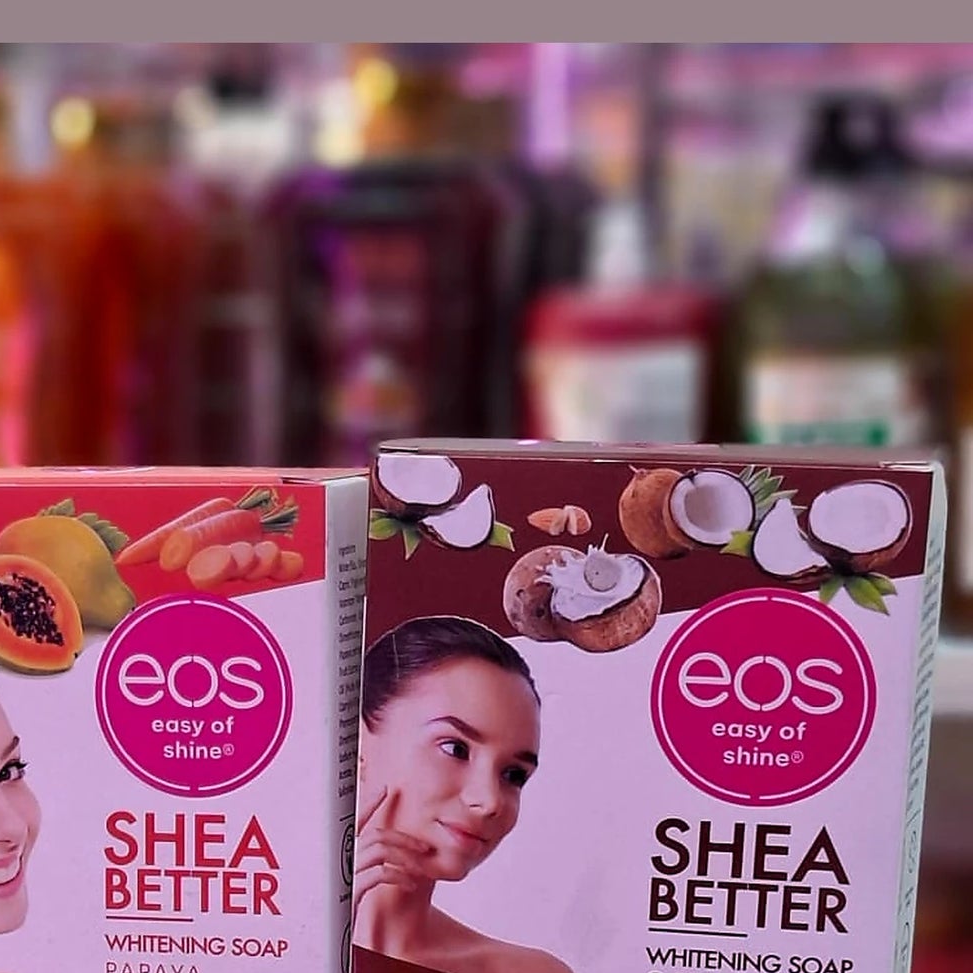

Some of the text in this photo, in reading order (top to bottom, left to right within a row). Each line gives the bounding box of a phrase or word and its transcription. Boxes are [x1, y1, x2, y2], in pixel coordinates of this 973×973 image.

[118, 654, 265, 710] eos
[678, 651, 844, 715] eos
[152, 716, 235, 737] easy of
[711, 722, 807, 743] easy of
[104, 811, 280, 870] SHEA
[651, 818, 850, 885] SHEA
[105, 869, 281, 916] BETTER
[649, 880, 848, 934] BETTER
[105, 934, 288, 957] WHITENING SOAP
